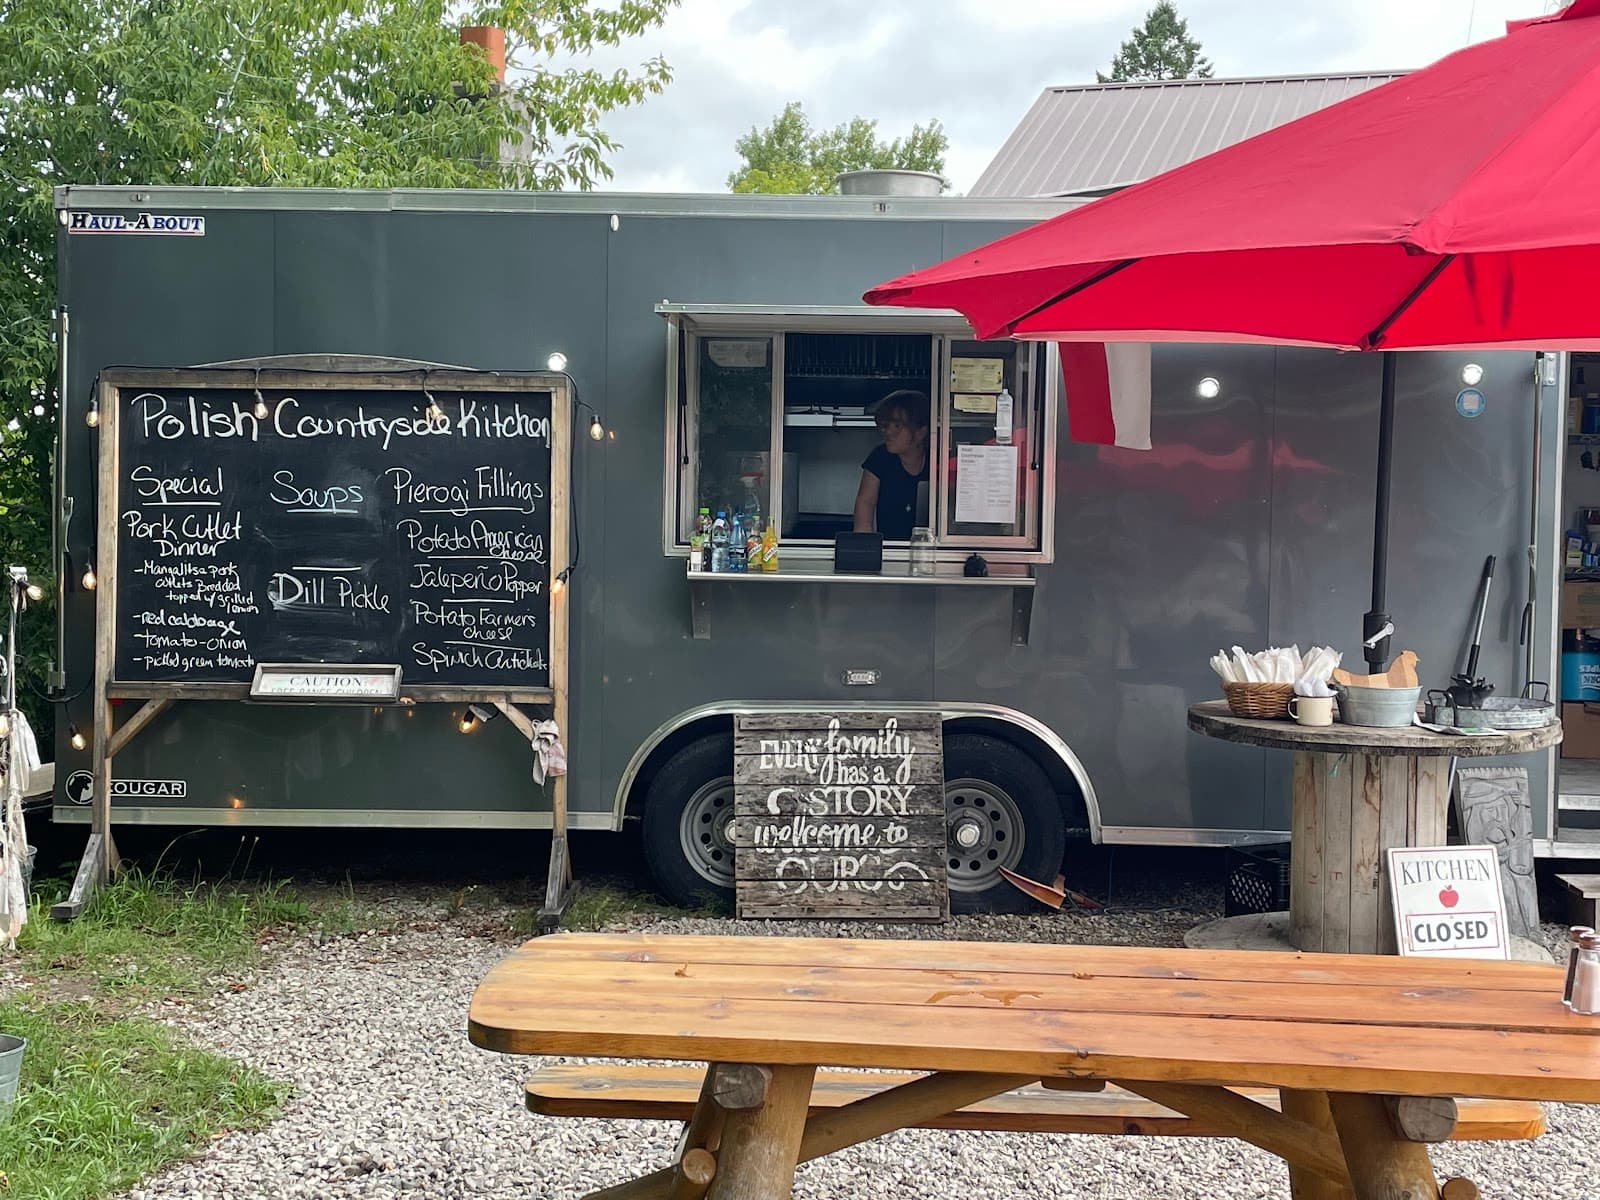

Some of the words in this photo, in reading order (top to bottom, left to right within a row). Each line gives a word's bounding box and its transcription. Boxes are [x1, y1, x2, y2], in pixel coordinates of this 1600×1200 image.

[131, 392, 258, 442] Polish
[273, 397, 453, 451] Countryside
[455, 398, 551, 450] Kitchen
[130, 465, 224, 504] Special
[270, 470, 364, 515] Soups
[384, 467, 470, 517] Pierogi
[474, 466, 544, 515] Fillings
[121, 510, 178, 541] Pork
[181, 511, 242, 541] Cutlet
[396, 518, 471, 553] Potato
[470, 519, 544, 552] American
[152, 539, 228, 557] Dinner
[267, 572, 326, 605] Dill
[332, 576, 391, 614] Pickle
[409, 599, 476, 626] Potato
[181, 656, 214, 672] green
[820, 717, 916, 786] family
[836, 760, 869, 785] has
[872, 765, 891, 785] a
[110, 782, 184, 795] OUGAR
[881, 821, 909, 845] to
[1400, 858, 1492, 886] KITCHEN
[1413, 920, 1489, 943] CLOSED
